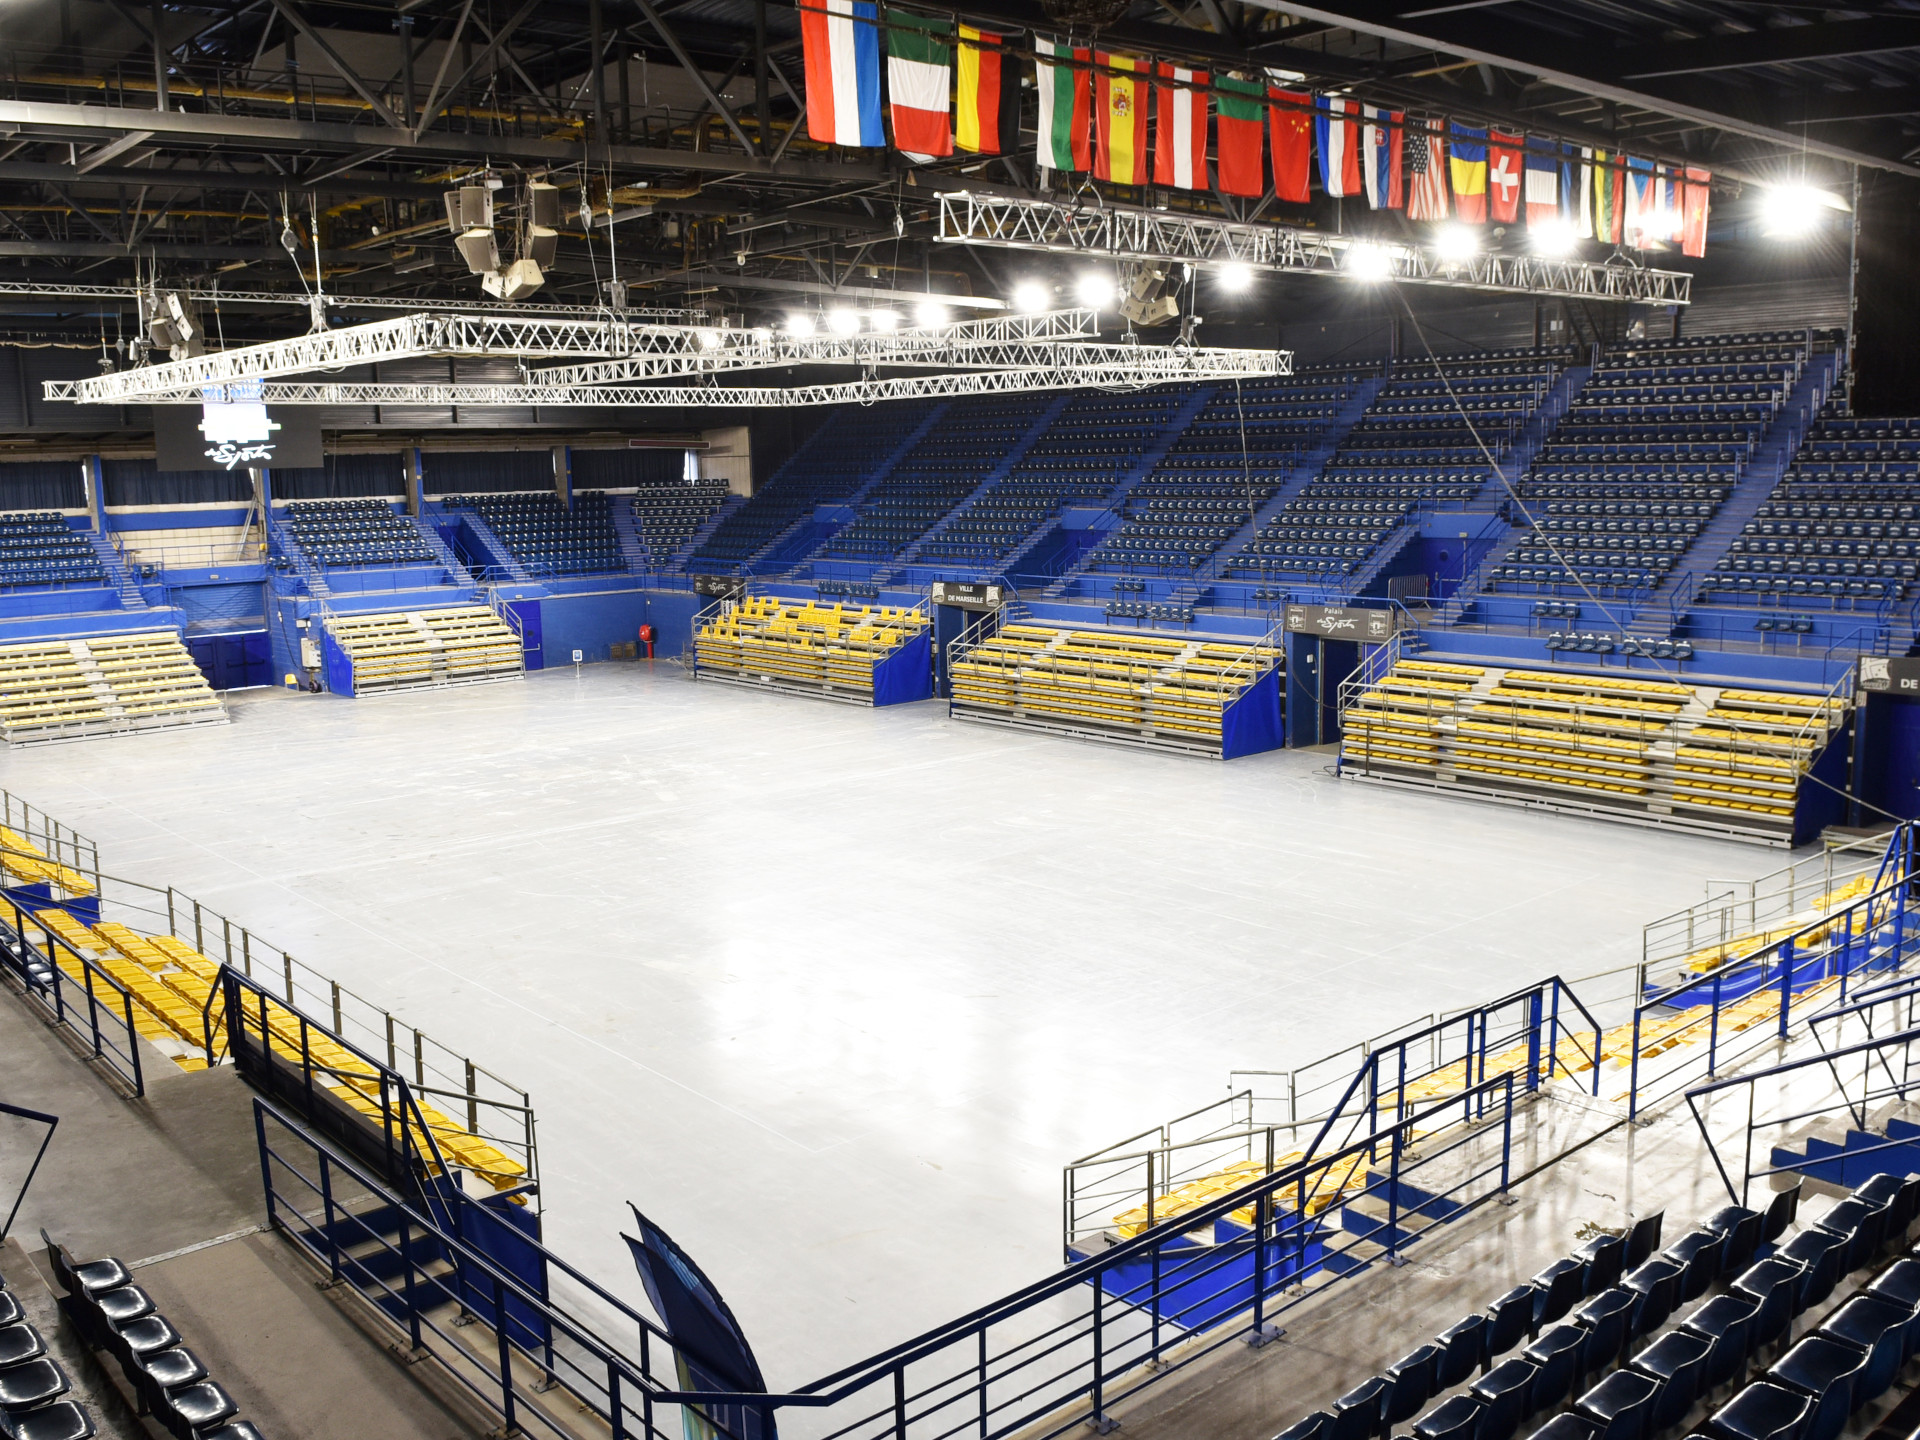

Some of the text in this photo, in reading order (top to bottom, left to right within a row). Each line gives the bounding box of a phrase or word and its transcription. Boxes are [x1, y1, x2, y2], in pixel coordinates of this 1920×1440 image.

[956, 596, 984, 604] MARSEILLE
[1324, 607, 1343, 615] Palais
[1321, 616, 1359, 634] Sports
[1900, 678, 1918, 689] DE
